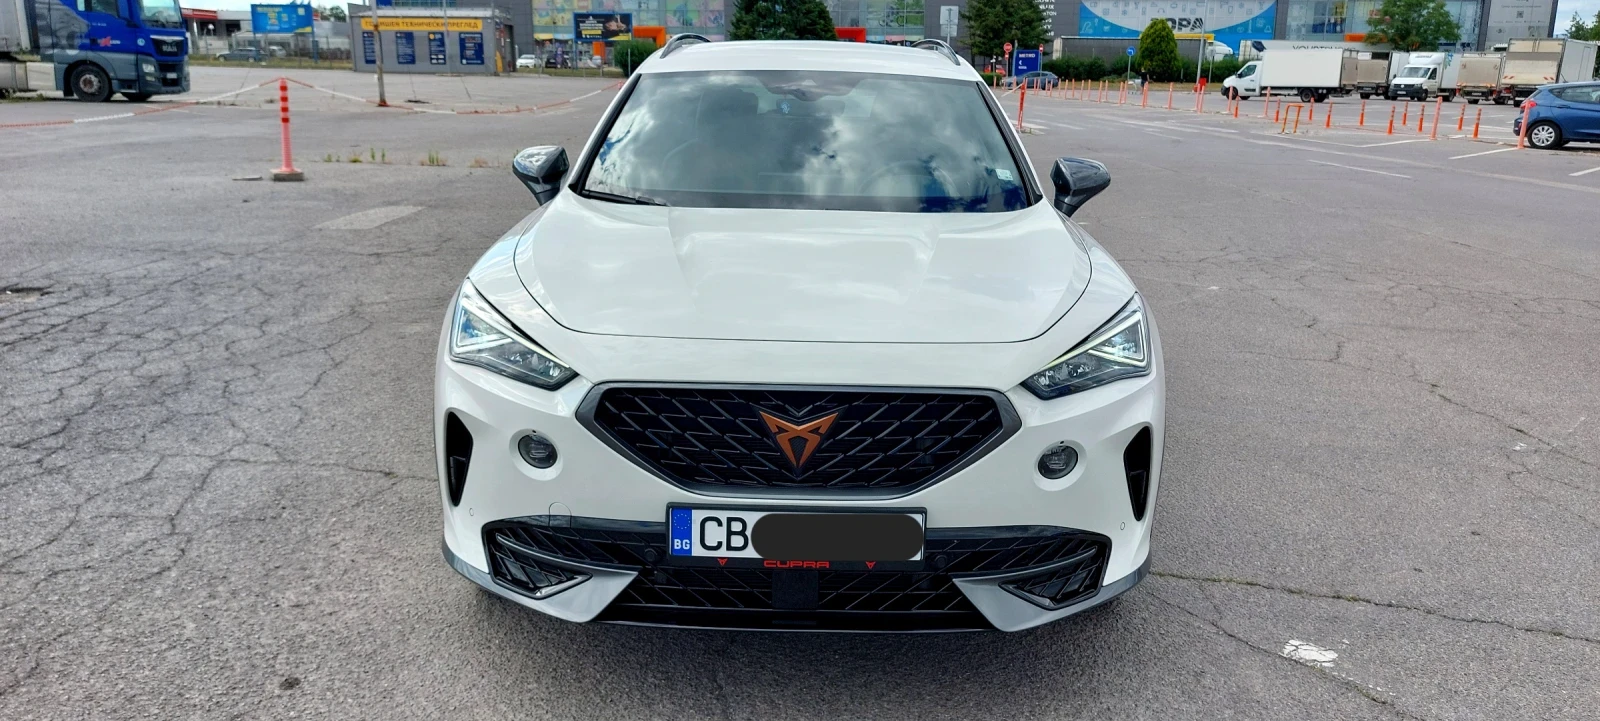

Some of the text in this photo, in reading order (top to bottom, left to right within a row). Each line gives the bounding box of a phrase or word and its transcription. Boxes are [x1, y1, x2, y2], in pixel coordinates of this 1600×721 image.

[1151, 17, 1204, 32] ОРА
[700, 515, 749, 551] CB
[674, 538, 691, 550] BG
[763, 560, 830, 569] CUPRA
